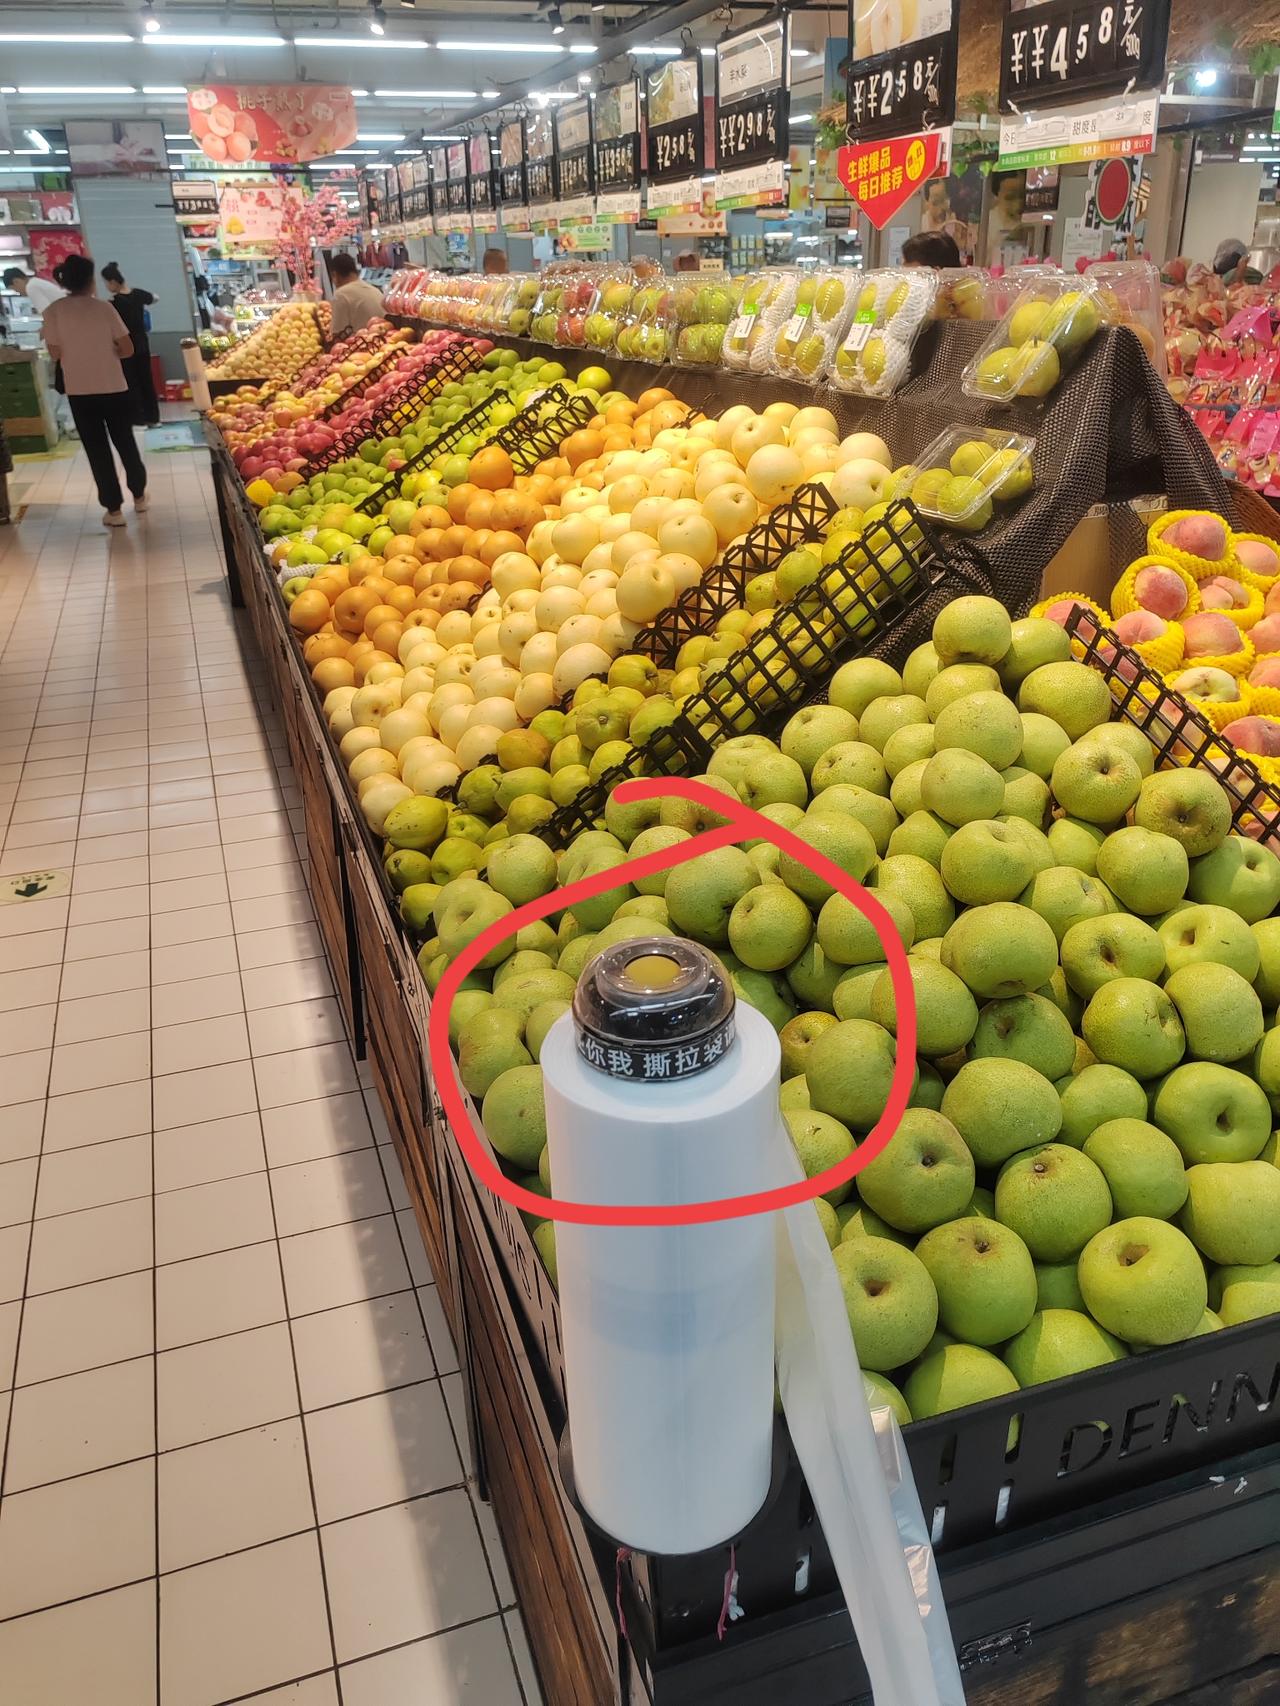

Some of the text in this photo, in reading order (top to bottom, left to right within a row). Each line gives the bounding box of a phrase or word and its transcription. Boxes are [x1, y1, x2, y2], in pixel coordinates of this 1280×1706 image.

[847, 146, 891, 183] 生鲜爆品
[858, 166, 904, 201] 每日推荐
